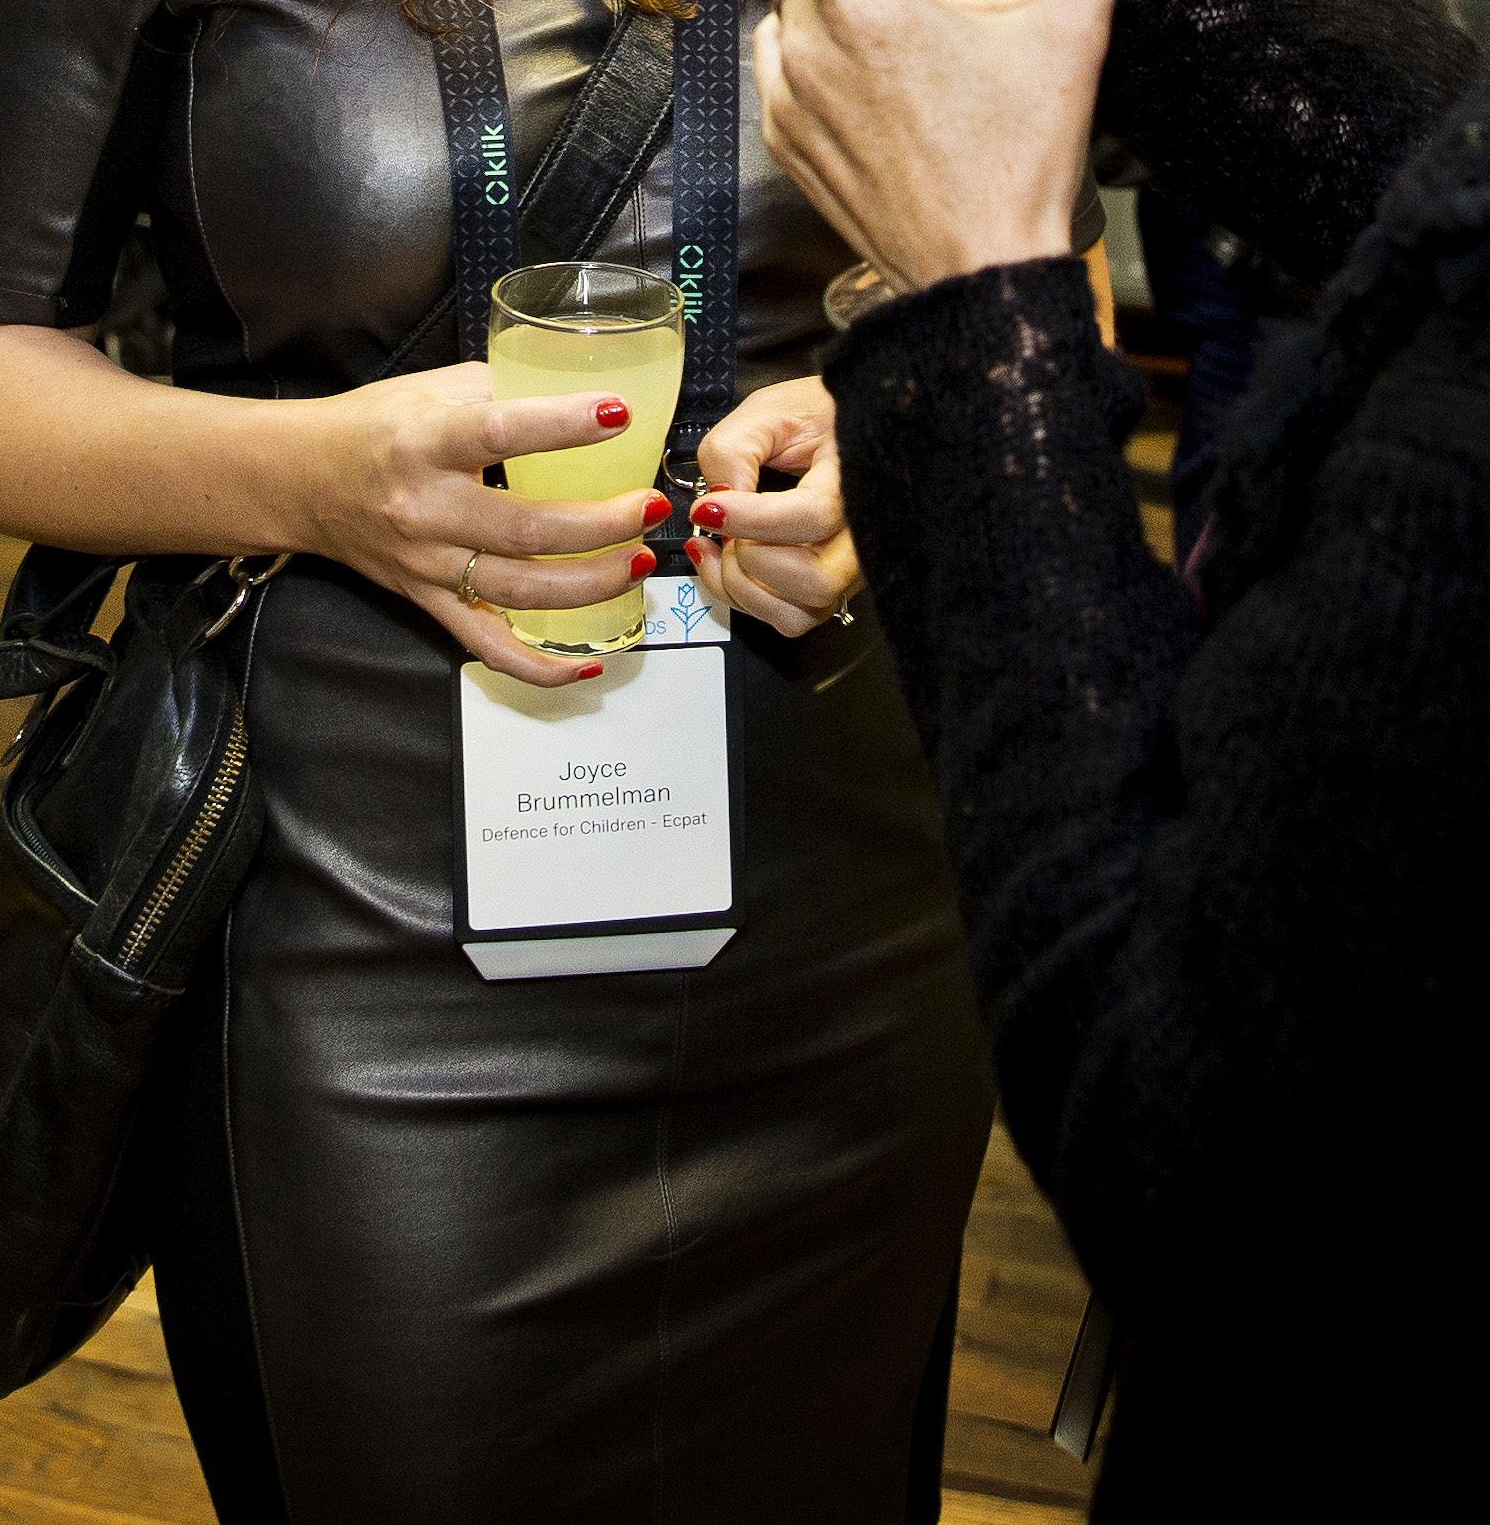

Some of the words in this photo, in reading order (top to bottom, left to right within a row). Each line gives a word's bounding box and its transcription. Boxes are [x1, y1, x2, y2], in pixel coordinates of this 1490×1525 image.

[559, 761, 627, 784] Joyce
[517, 786, 671, 813] Brummelman
[482, 826, 549, 842] Defence
[553, 823, 575, 837] for
[580, 818, 646, 835] Children
[663, 812, 708, 830] Ecpat
